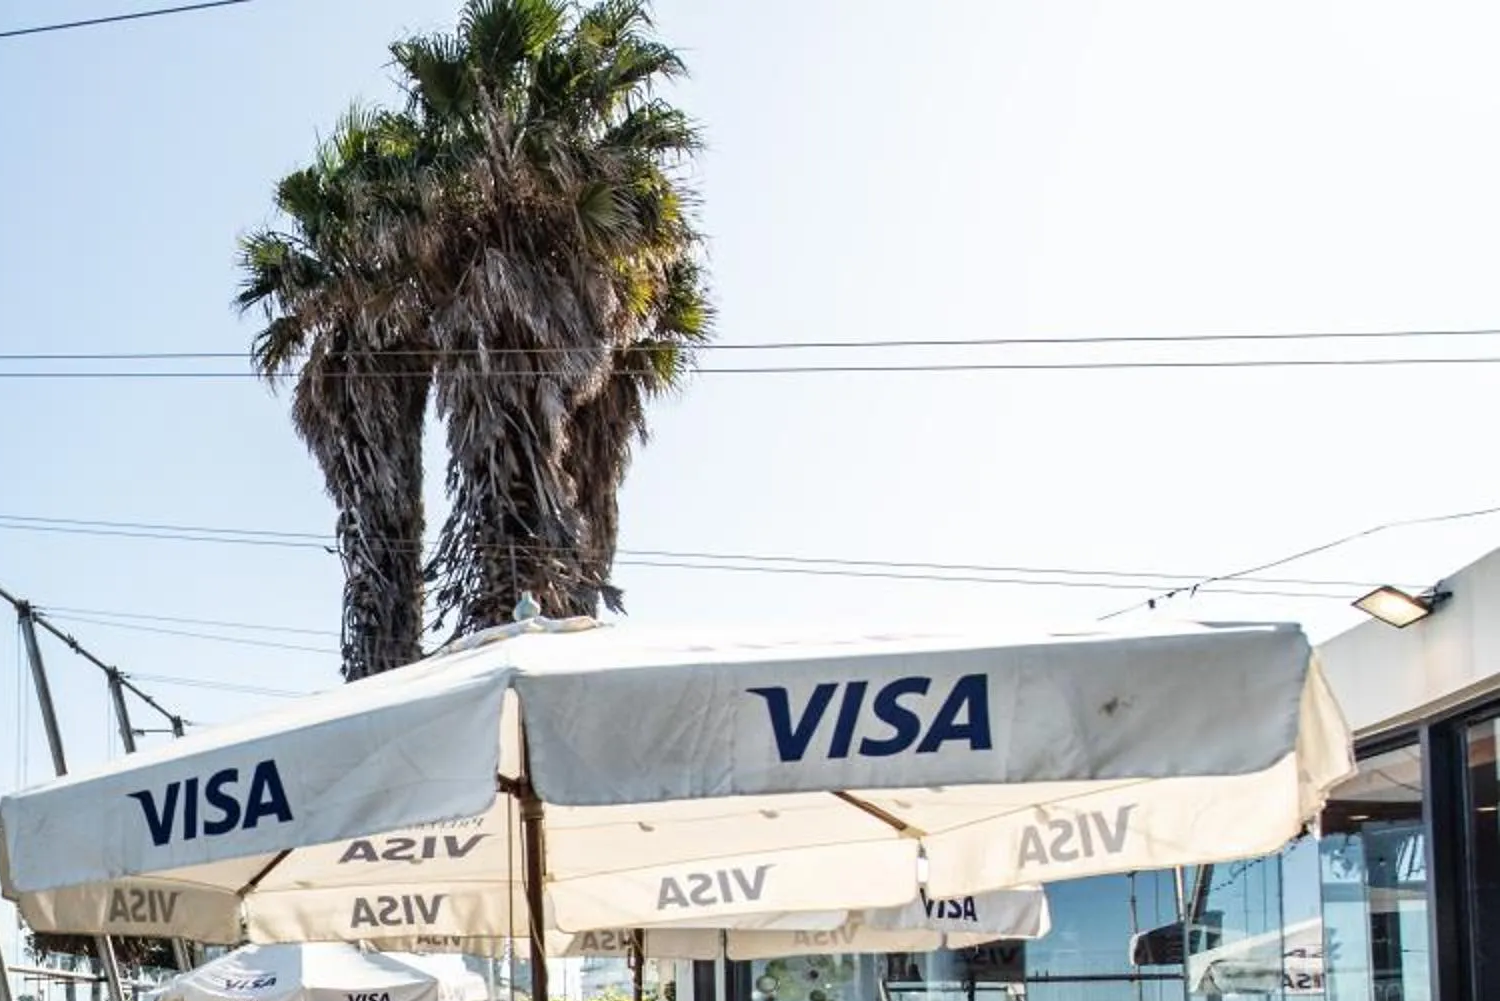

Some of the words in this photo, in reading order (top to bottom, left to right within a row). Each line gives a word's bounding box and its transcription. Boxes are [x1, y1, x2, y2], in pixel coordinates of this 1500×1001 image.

[746, 674, 992, 761] VISA
[127, 760, 293, 846] VISA
[920, 888, 977, 921] VISA
[225, 977, 277, 990] VISA
